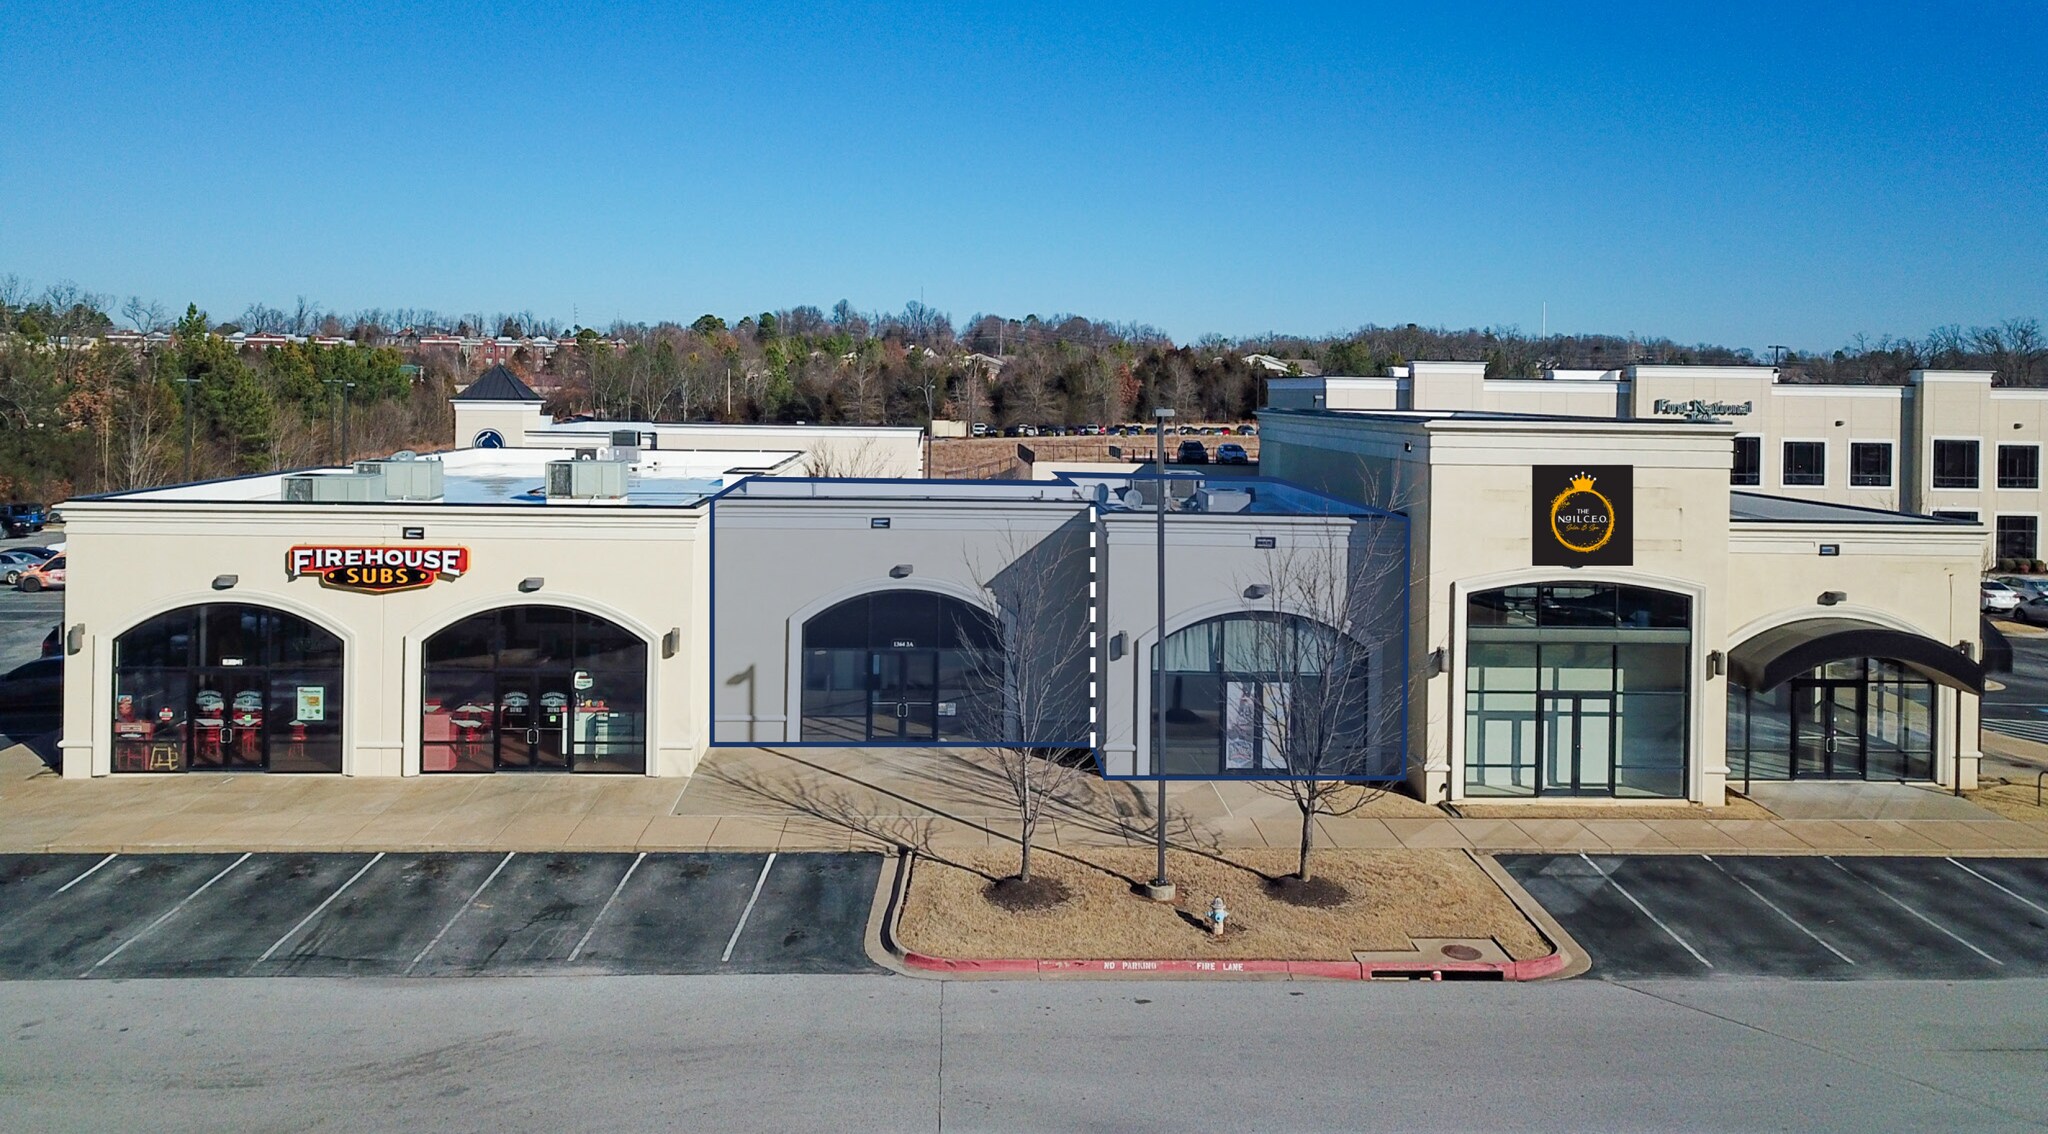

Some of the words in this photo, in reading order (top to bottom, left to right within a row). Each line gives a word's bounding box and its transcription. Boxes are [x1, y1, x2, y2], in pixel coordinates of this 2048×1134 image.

[292, 548, 461, 576] FIREHOUSE
[346, 568, 409, 584] SUBS
[1104, 961, 1115, 969] NO
[1122, 961, 1157, 970] PARKING
[1196, 962, 1216, 971] FIRE
[1222, 962, 1244, 972] LANE
